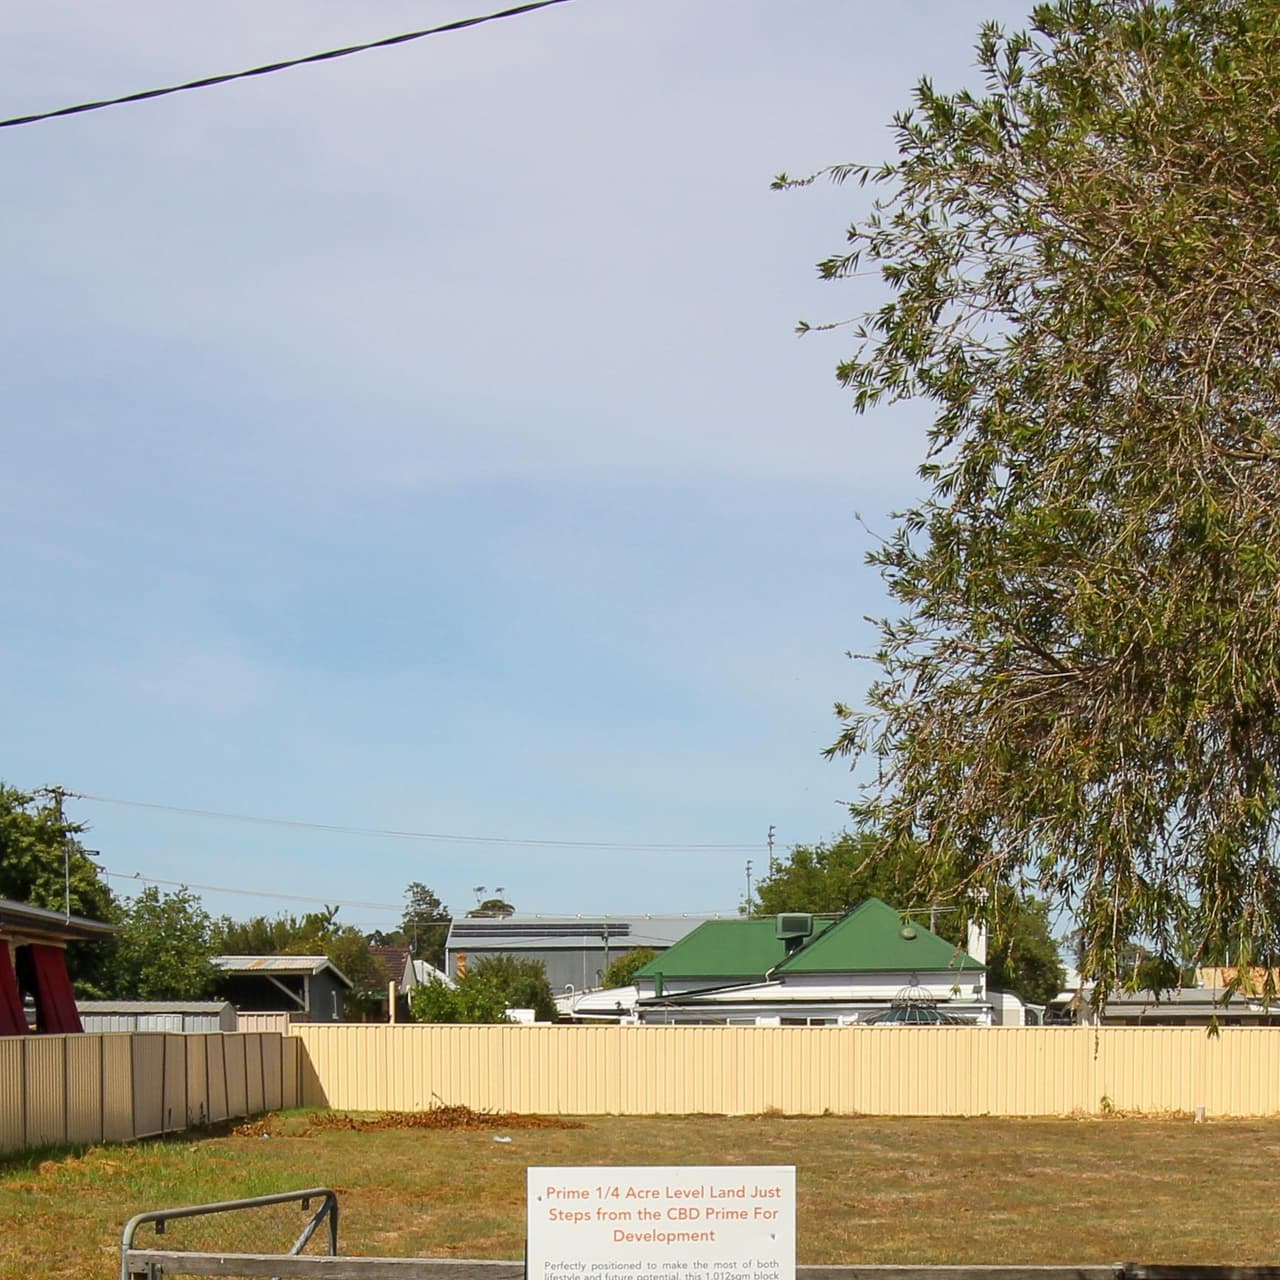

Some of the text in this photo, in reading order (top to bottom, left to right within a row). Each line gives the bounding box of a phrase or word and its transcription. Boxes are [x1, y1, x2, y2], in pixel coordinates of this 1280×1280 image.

[546, 1186, 781, 1200] Prime 1/4 Acre Level Land Just
[549, 1208, 778, 1224] Steps from the CBD Prime For
[613, 1229, 715, 1245] Development
[545, 1260, 779, 1272] Perfectly positioned to make the most of both
[685, 1273, 701, 1280] this
[754, 1272, 779, 1280] block
